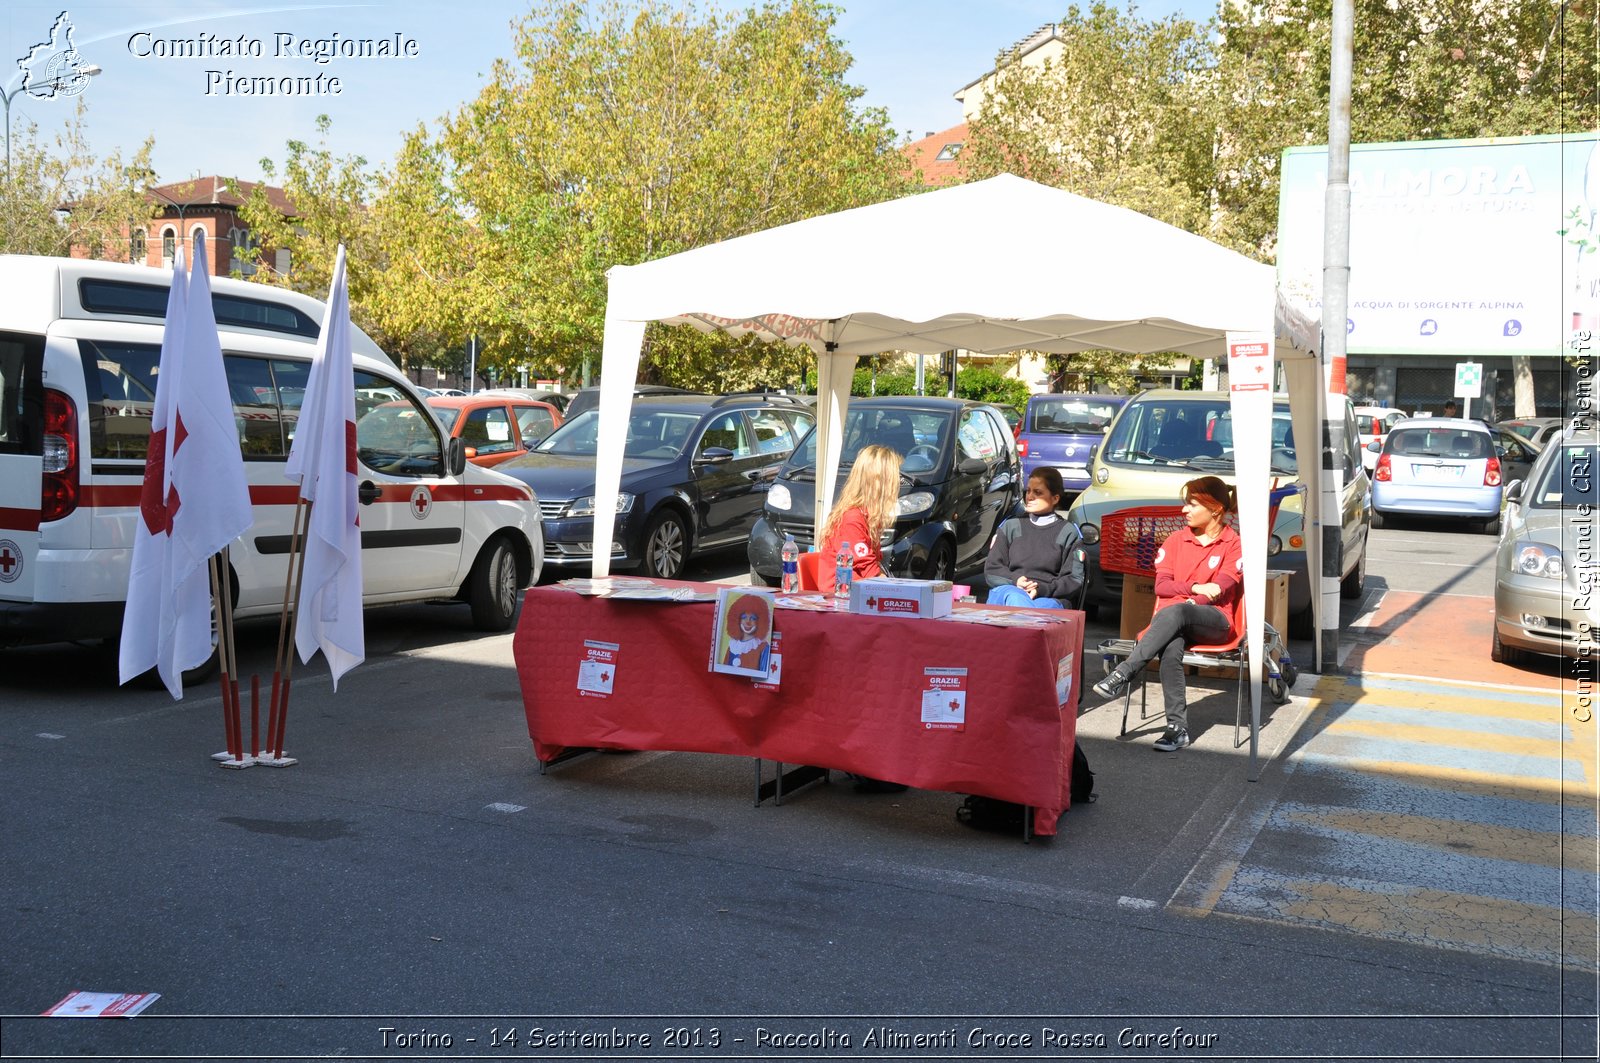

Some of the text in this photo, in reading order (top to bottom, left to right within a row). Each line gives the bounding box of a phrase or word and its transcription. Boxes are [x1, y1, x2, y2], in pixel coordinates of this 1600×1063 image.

[1354, 301, 1394, 310] ACQUA
[1398, 301, 1410, 309] DI
[1414, 301, 1474, 309] SORGENTE
[1479, 301, 1525, 309] ALPINA
[883, 600, 914, 609] GRAZIE.
[587, 649, 613, 659] GRAZIE.
[929, 677, 961, 685] GRAZIE.
